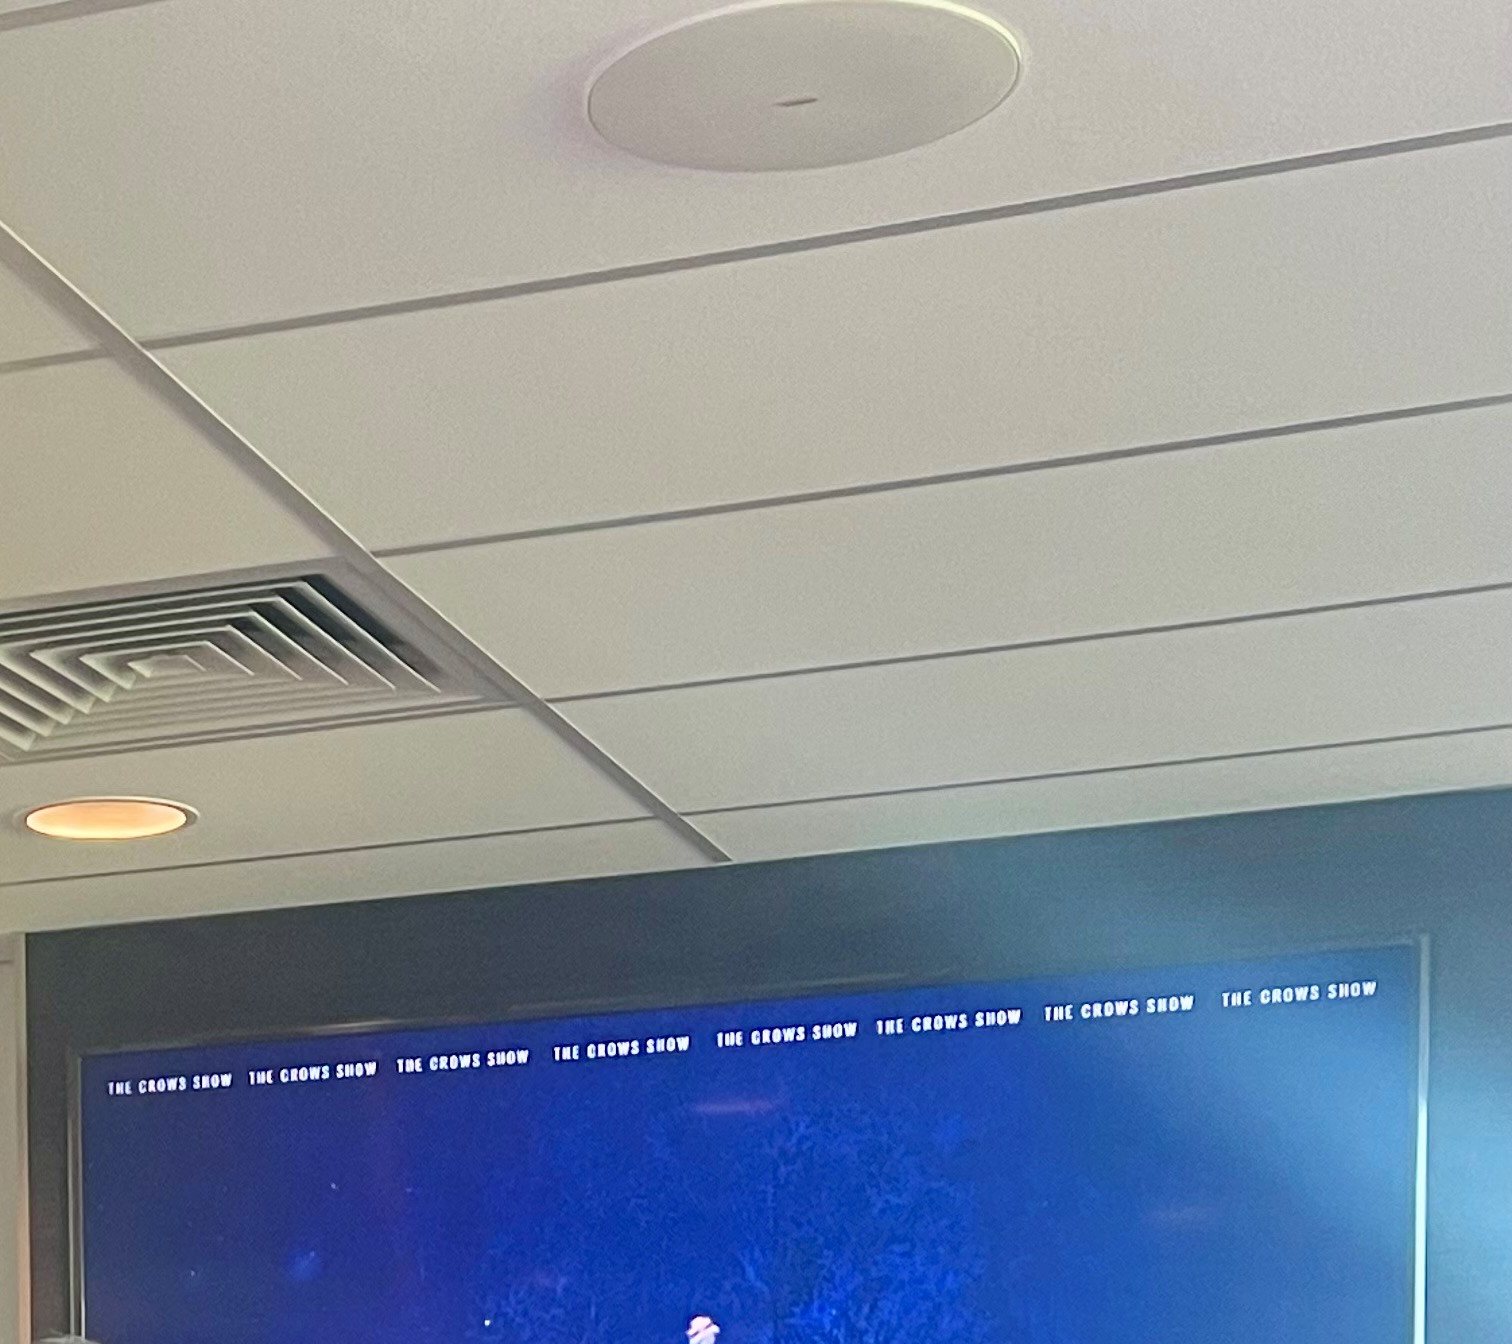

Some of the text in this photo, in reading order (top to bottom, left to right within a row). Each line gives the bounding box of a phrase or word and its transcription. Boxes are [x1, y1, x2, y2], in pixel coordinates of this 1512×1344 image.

[1221, 981, 1377, 1008] THE CROWS SHOW
[1044, 995, 1194, 1022] THE CROWS SHOW
[876, 1009, 1021, 1035] THE CROWS SHOW
[717, 1022, 857, 1048] THE CROWS SHOW
[396, 1049, 529, 1073] THE CROWS SHOW
[553, 1036, 690, 1061] THE CROWS SHOW
[108, 1073, 232, 1095] THE CROWS SHOW
[248, 1061, 377, 1085] THE CROWS SHOW
